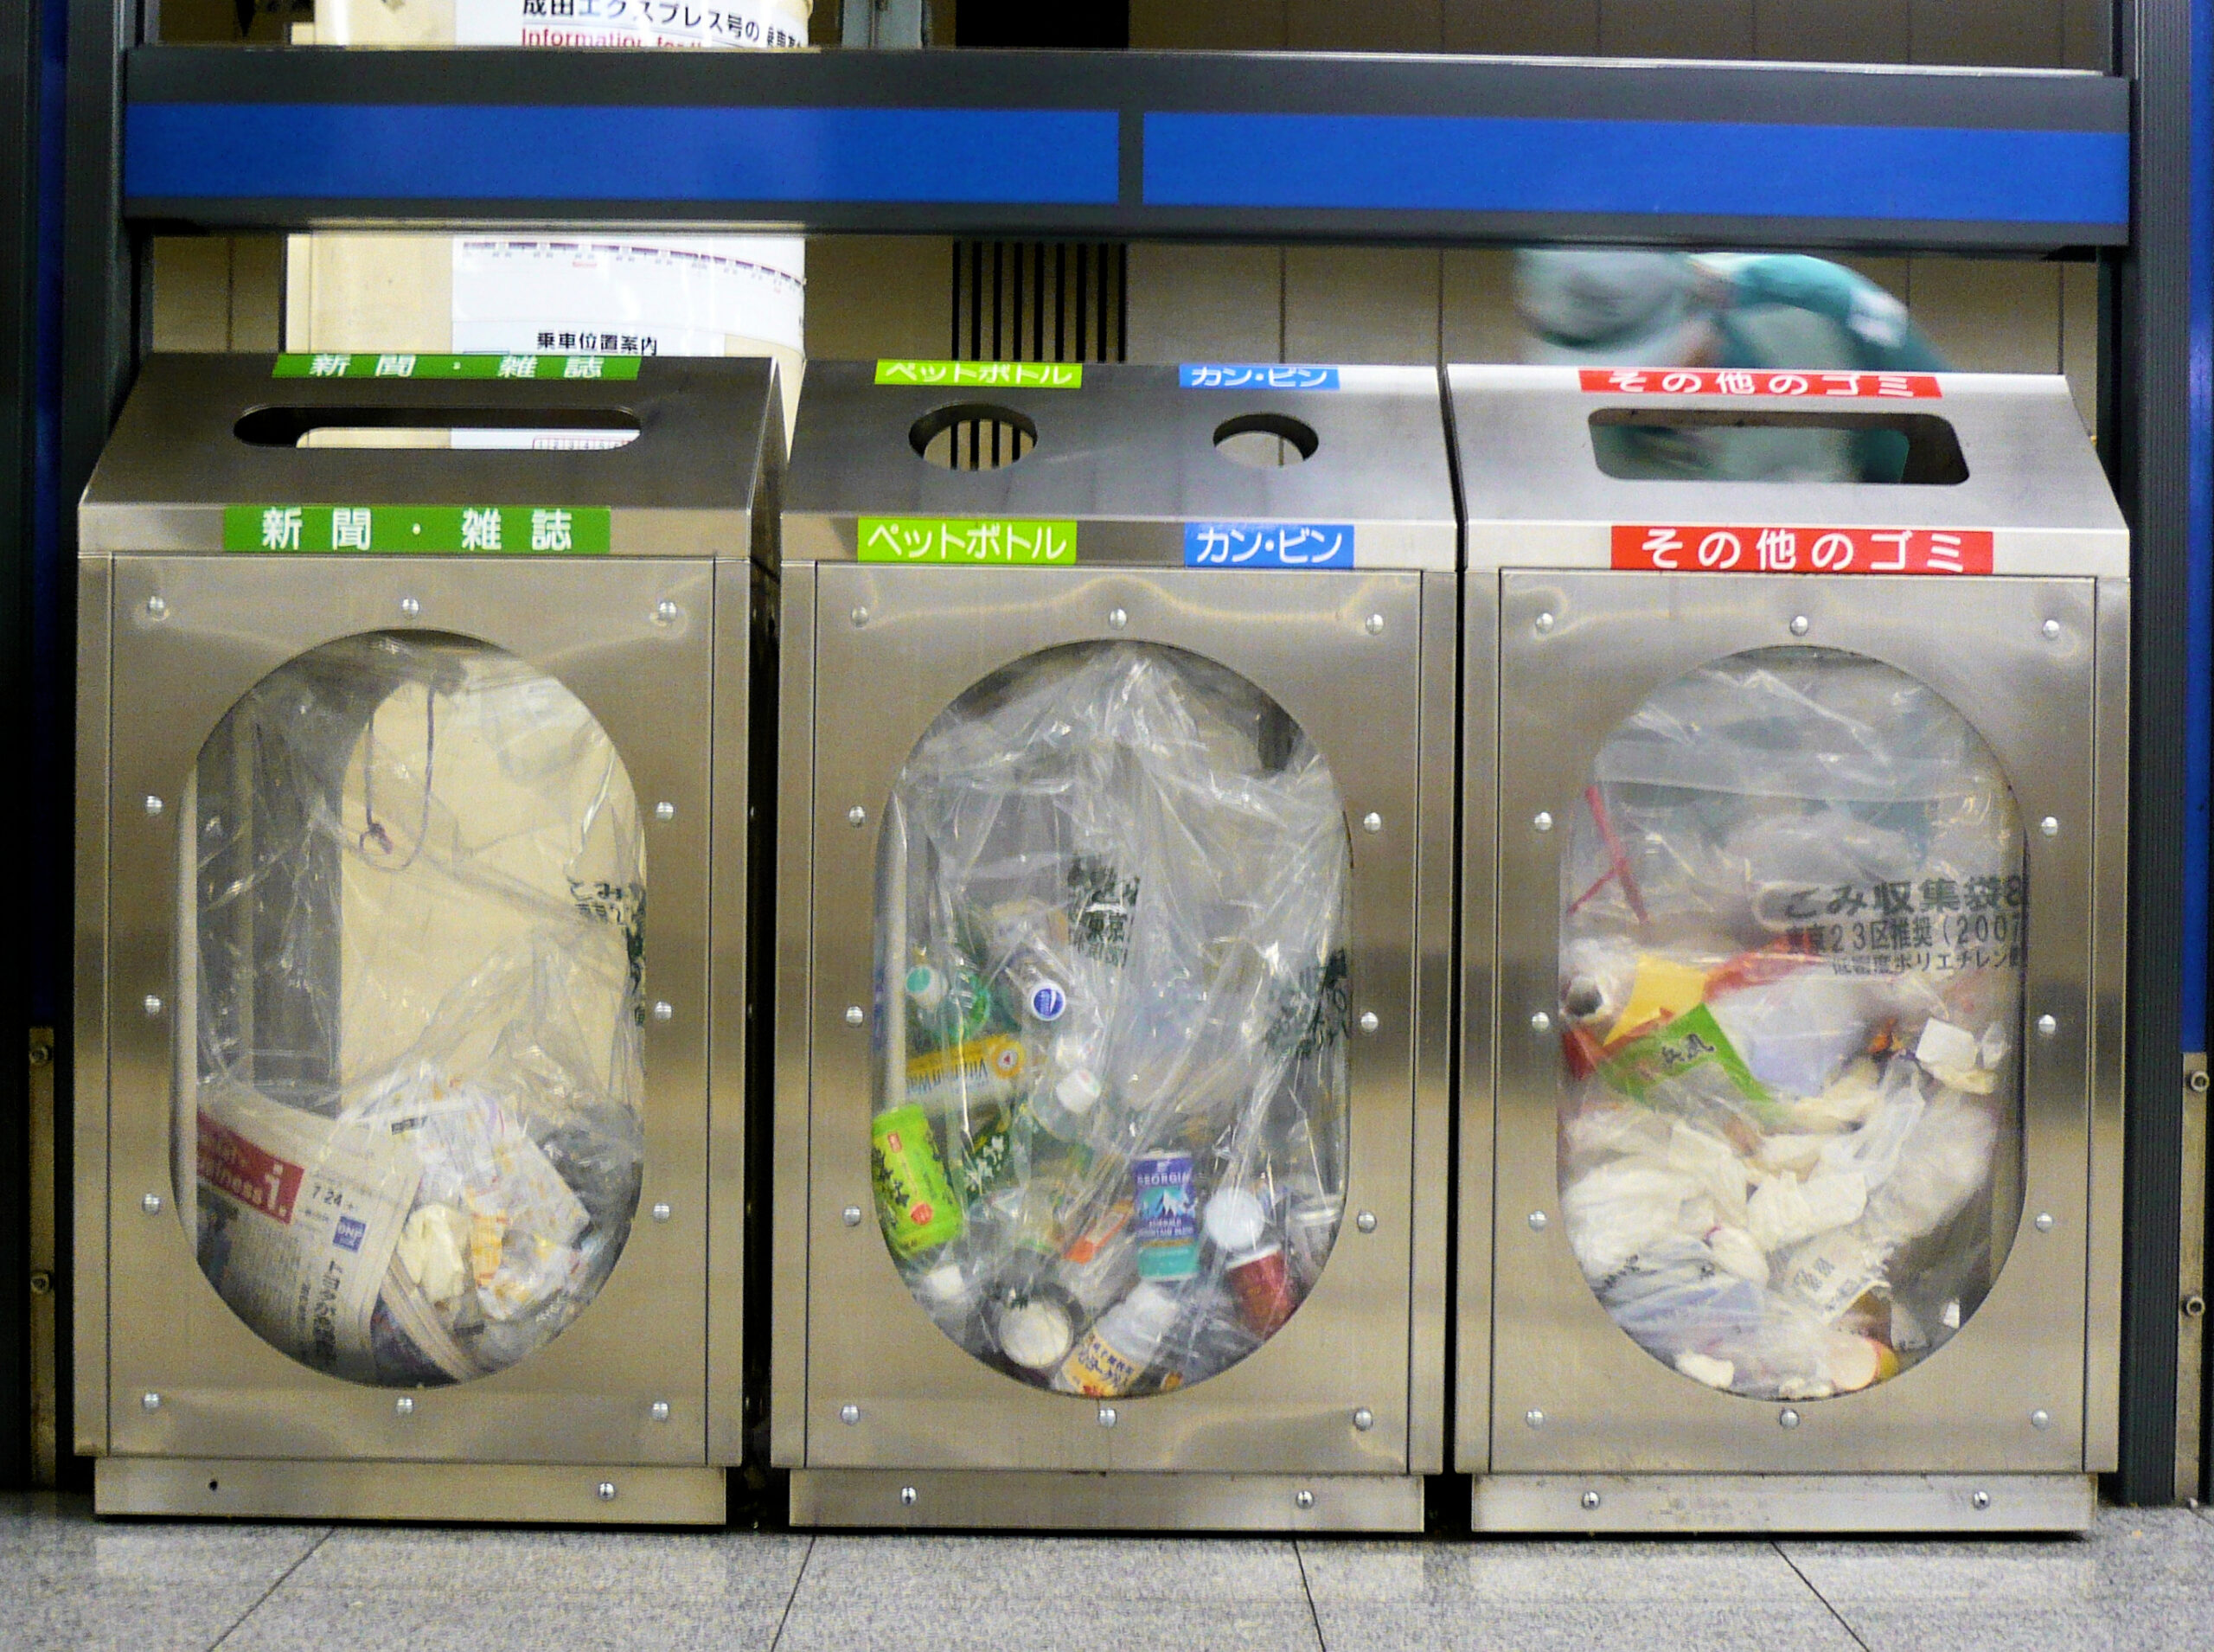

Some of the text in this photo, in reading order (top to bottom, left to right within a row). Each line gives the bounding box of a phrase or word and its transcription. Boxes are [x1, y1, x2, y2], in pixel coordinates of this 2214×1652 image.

[537, 332, 657, 355] 乗車位置案内
[885, 362, 1072, 385] ペットボトル
[1191, 365, 1328, 387] カン・ビン
[1609, 372, 1913, 398] その他のゴミ
[867, 524, 1066, 560] ペットボトル
[1197, 526, 1342, 564] カン・ビン
[1641, 528, 1964, 573] その他のゴミ
